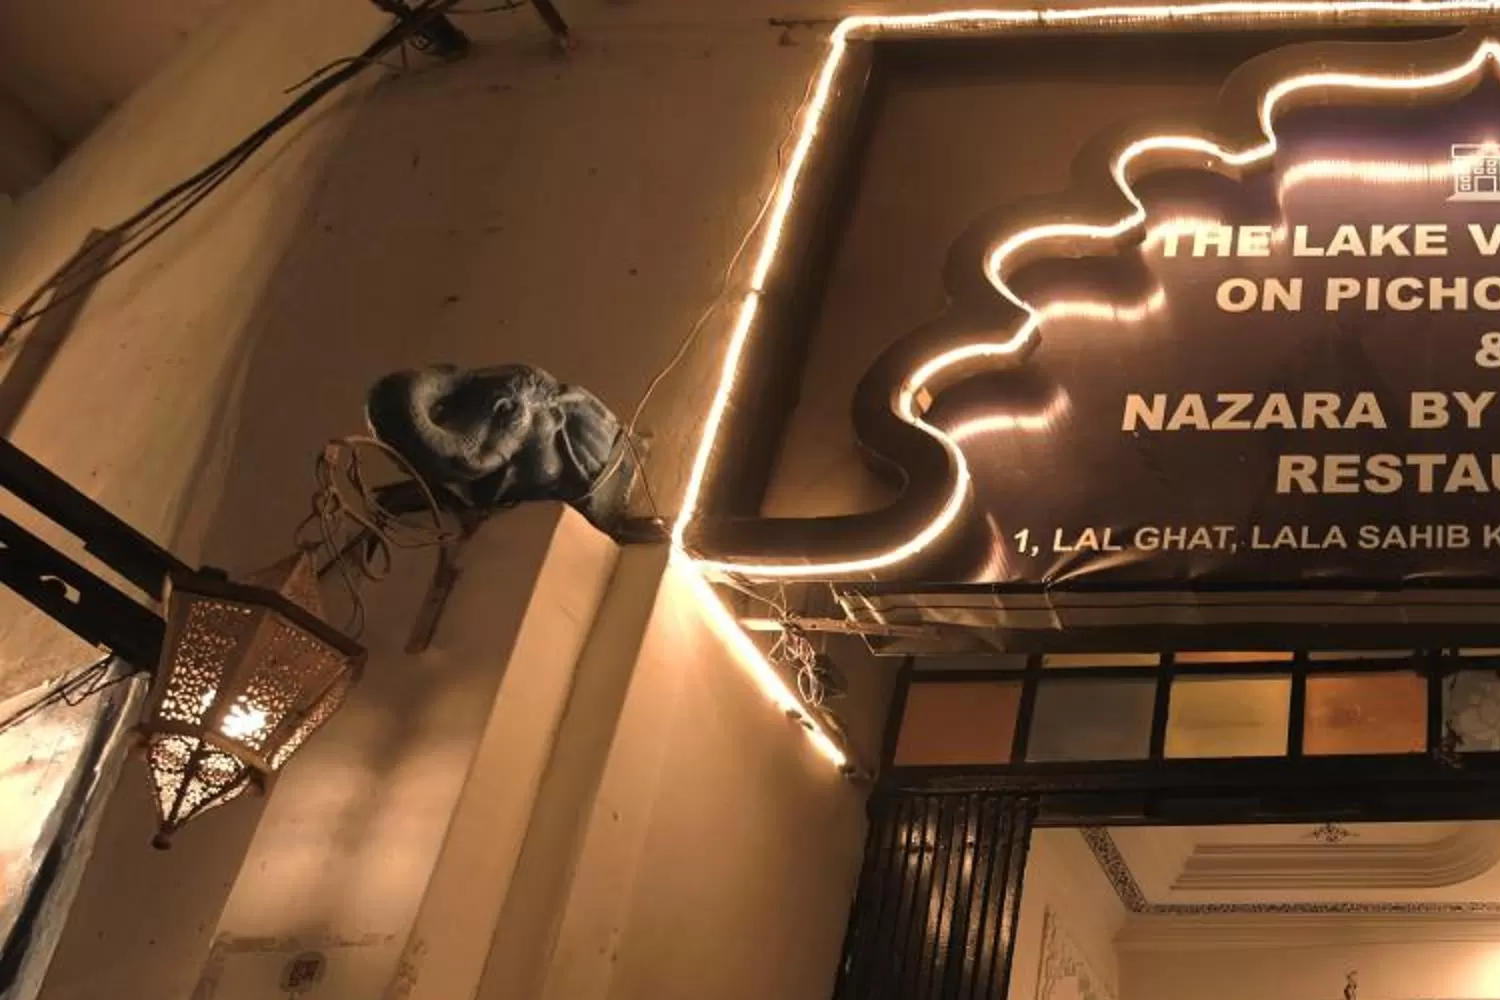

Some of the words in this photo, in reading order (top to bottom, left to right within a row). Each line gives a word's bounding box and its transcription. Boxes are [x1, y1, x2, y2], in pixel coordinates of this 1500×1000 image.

[1161, 224, 1276, 258] THE
[1293, 225, 1448, 257] LAKE
[1215, 277, 1302, 312] ON
[1121, 391, 1388, 432] NAZARA
[1409, 390, 1497, 430] BY
[1013, 527, 1039, 557] 1,
[1053, 527, 1122, 552] LAL
[1133, 525, 1237, 554] GHAT,
[1250, 525, 1348, 551] LALA
[1357, 524, 1470, 550] SAHIB
